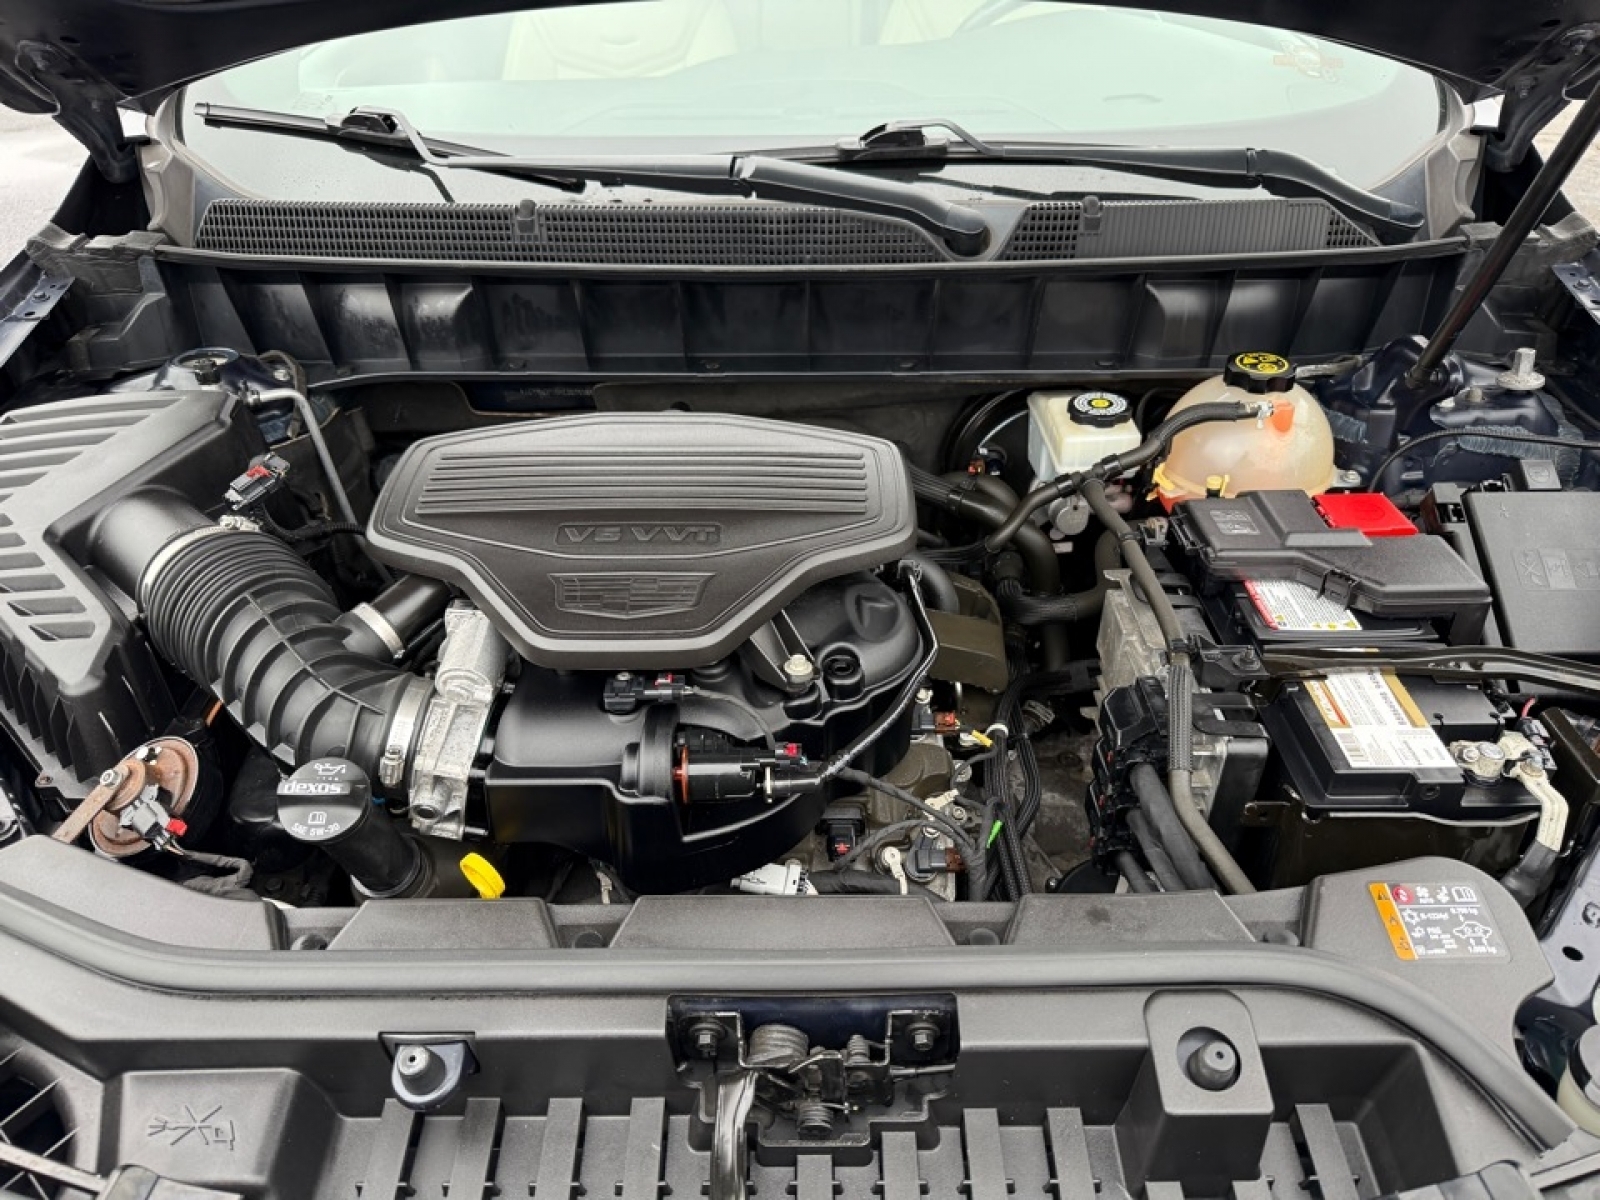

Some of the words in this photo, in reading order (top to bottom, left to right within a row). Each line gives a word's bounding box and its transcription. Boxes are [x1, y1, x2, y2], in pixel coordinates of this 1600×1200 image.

[564, 526, 621, 543] V6
[631, 526, 716, 543] VVT
[284, 780, 342, 794] dexos
[291, 822, 308, 836] SAE
